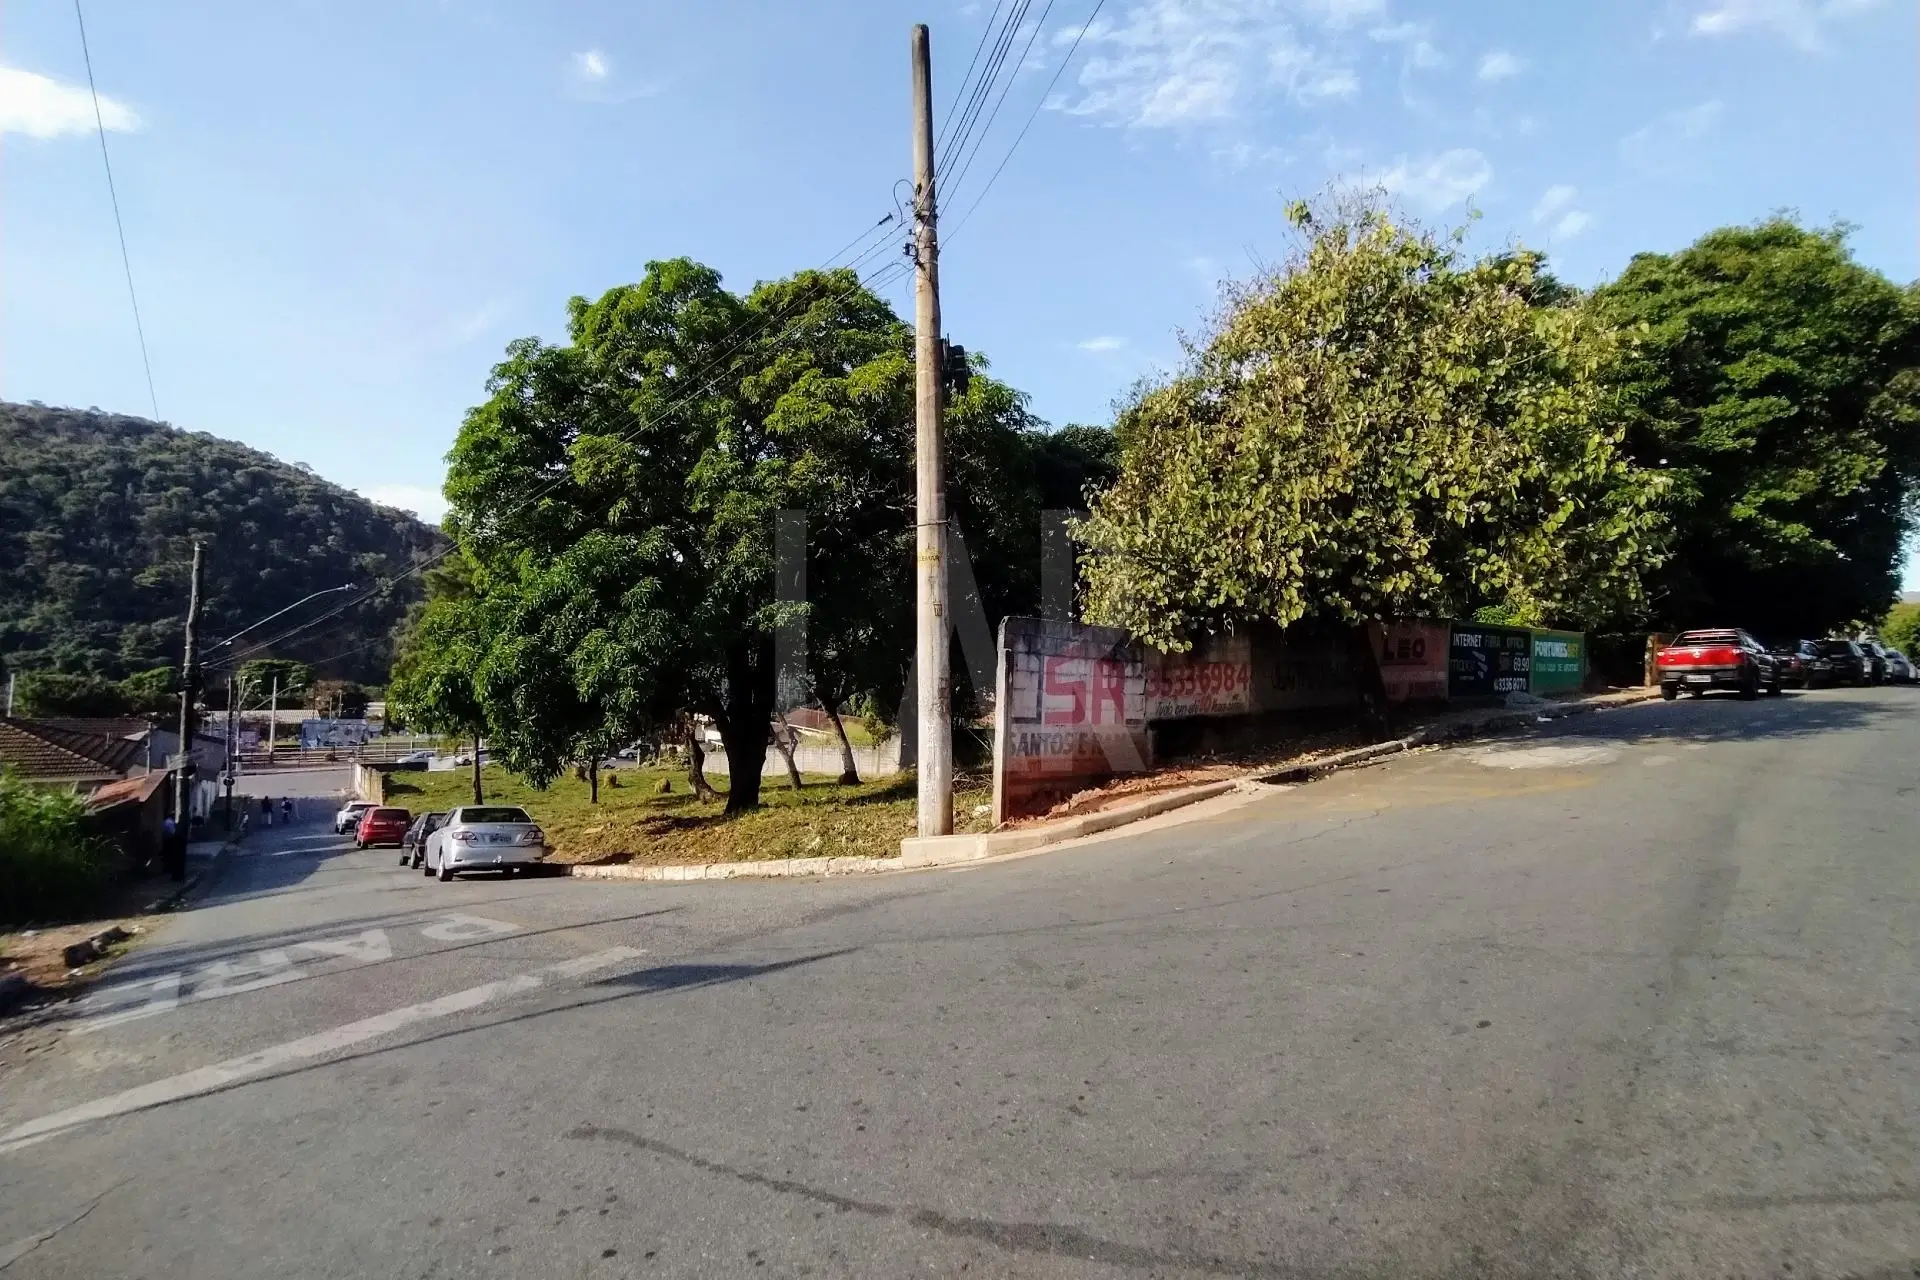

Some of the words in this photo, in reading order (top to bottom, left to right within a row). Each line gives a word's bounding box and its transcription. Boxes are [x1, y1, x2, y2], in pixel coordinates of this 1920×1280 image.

[1383, 638, 1426, 660] LEO
[1452, 633, 1482, 648] INTERNET
[1043, 655, 1126, 725] SR
